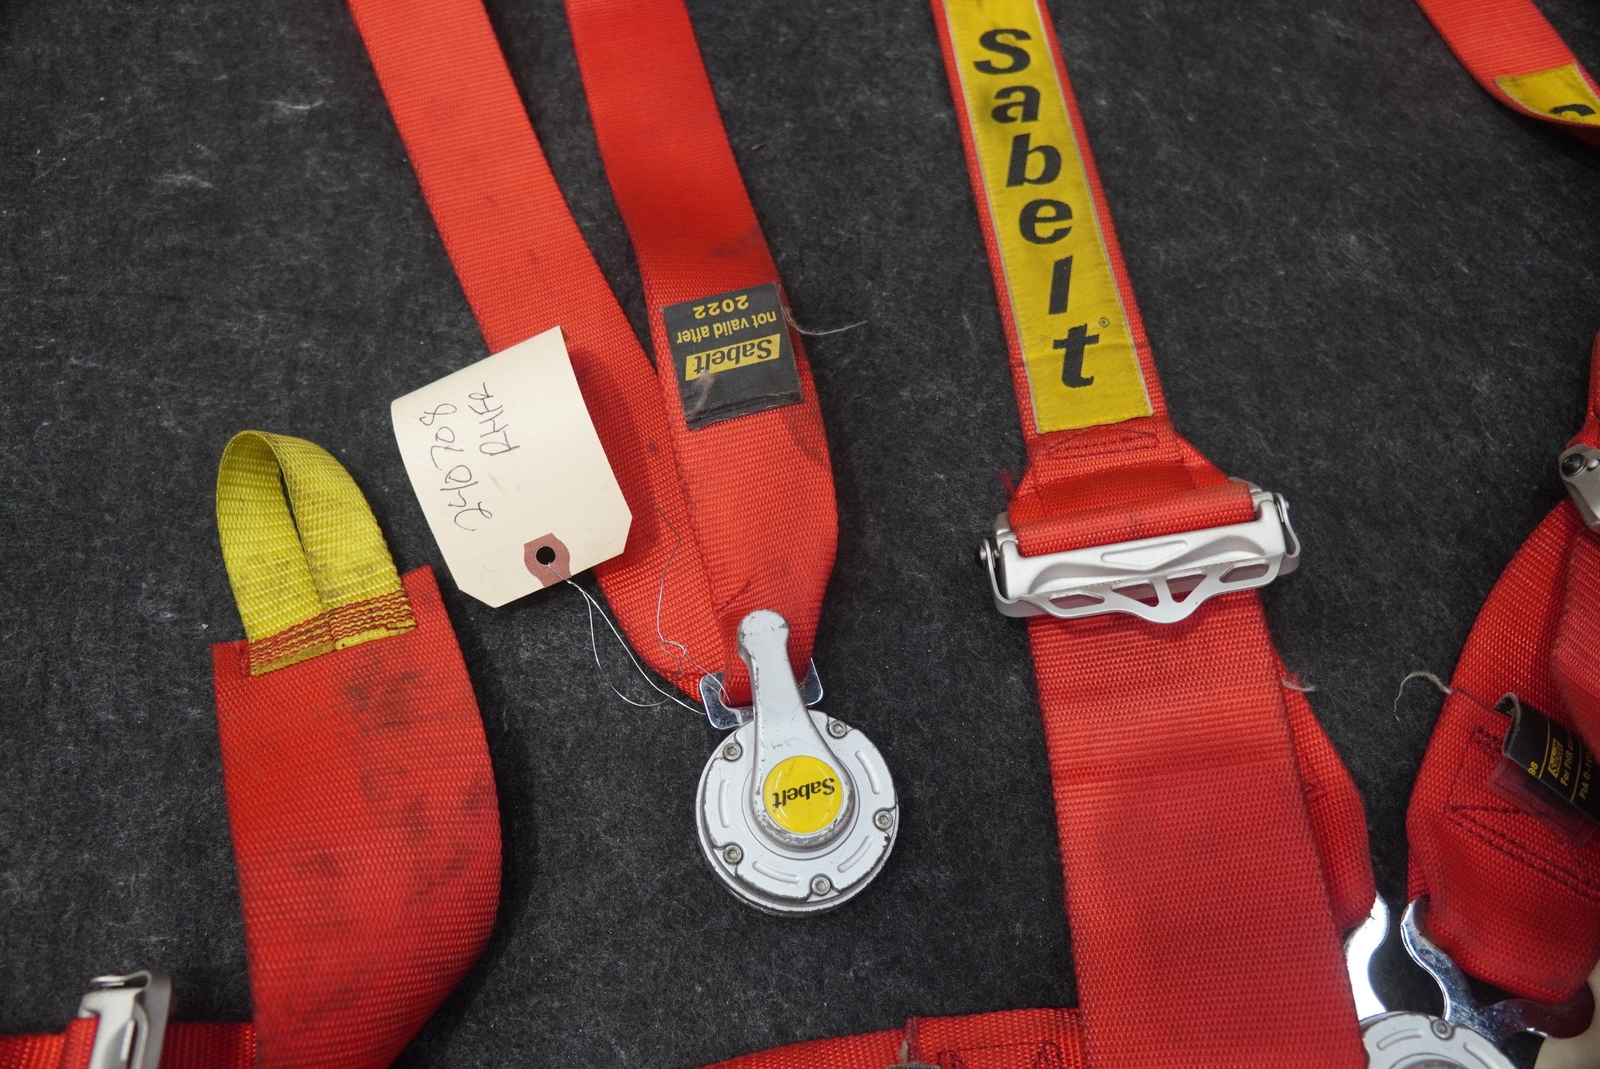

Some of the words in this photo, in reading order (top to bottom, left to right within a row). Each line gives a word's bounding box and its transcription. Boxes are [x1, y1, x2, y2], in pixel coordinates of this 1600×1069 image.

[974, 28, 1099, 389] Sabelt
[692, 294, 749, 319] 2022
[713, 318, 750, 339] valid
[752, 311, 777, 328] not
[676, 325, 710, 344] after
[694, 339, 773, 375] Sabelt
[419, 403, 492, 532] 240708
[1548, 739, 1563, 778] Sabelt
[1560, 770, 1570, 787] For
[1579, 782, 1590, 800] FIA
[772, 777, 836, 809] Sabelt
